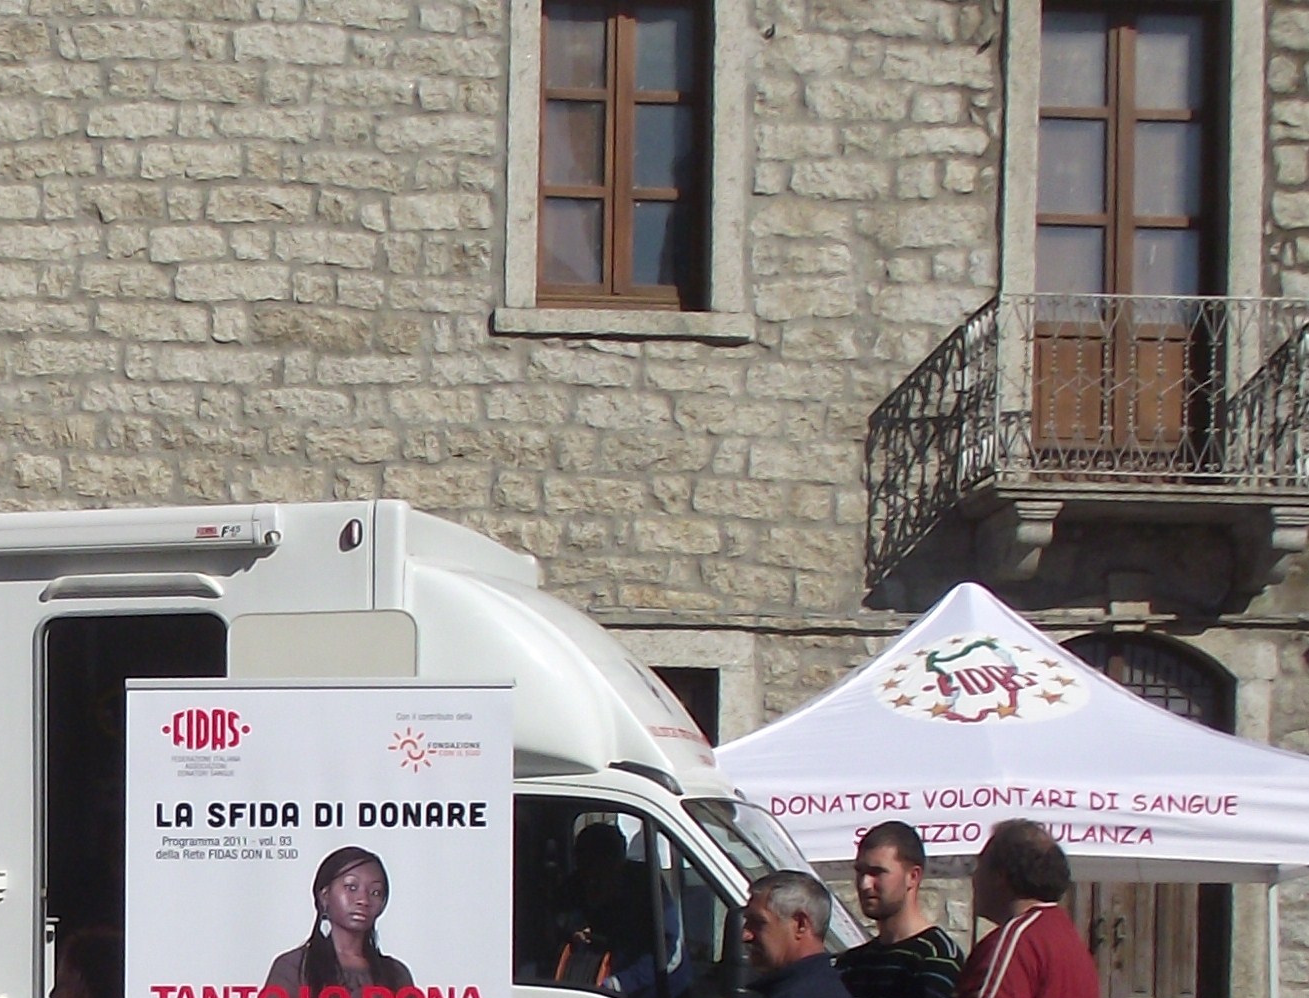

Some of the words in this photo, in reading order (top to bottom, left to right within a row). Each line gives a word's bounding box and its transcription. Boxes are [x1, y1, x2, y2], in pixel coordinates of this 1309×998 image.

[937, 666, 1038, 697] FIDAS
[173, 709, 240, 750] FIDAS
[771, 791, 911, 816] DONATORI
[923, 787, 1078, 809] VOLONTARI
[1090, 791, 1120, 811] DI
[1132, 794, 1239, 816] SANGUE
[156, 803, 192, 827] LA
[207, 803, 299, 827] SFIDA
[315, 803, 342, 827] DI
[359, 803, 487, 827] DONARE
[162, 836, 220, 848] Programma
[223, 836, 247, 846] 2011
[259, 836, 276, 846] vol.
[854, 823, 981, 845] SIZIO
[1037, 822, 1154, 845] ULANZA
[156, 849, 180, 860] della
[183, 849, 206, 860] Rete
[208, 849, 238, 860] FIDAS
[241, 849, 262, 860] CON
[265, 849, 274, 860] IL
[277, 849, 299, 860] SUD
